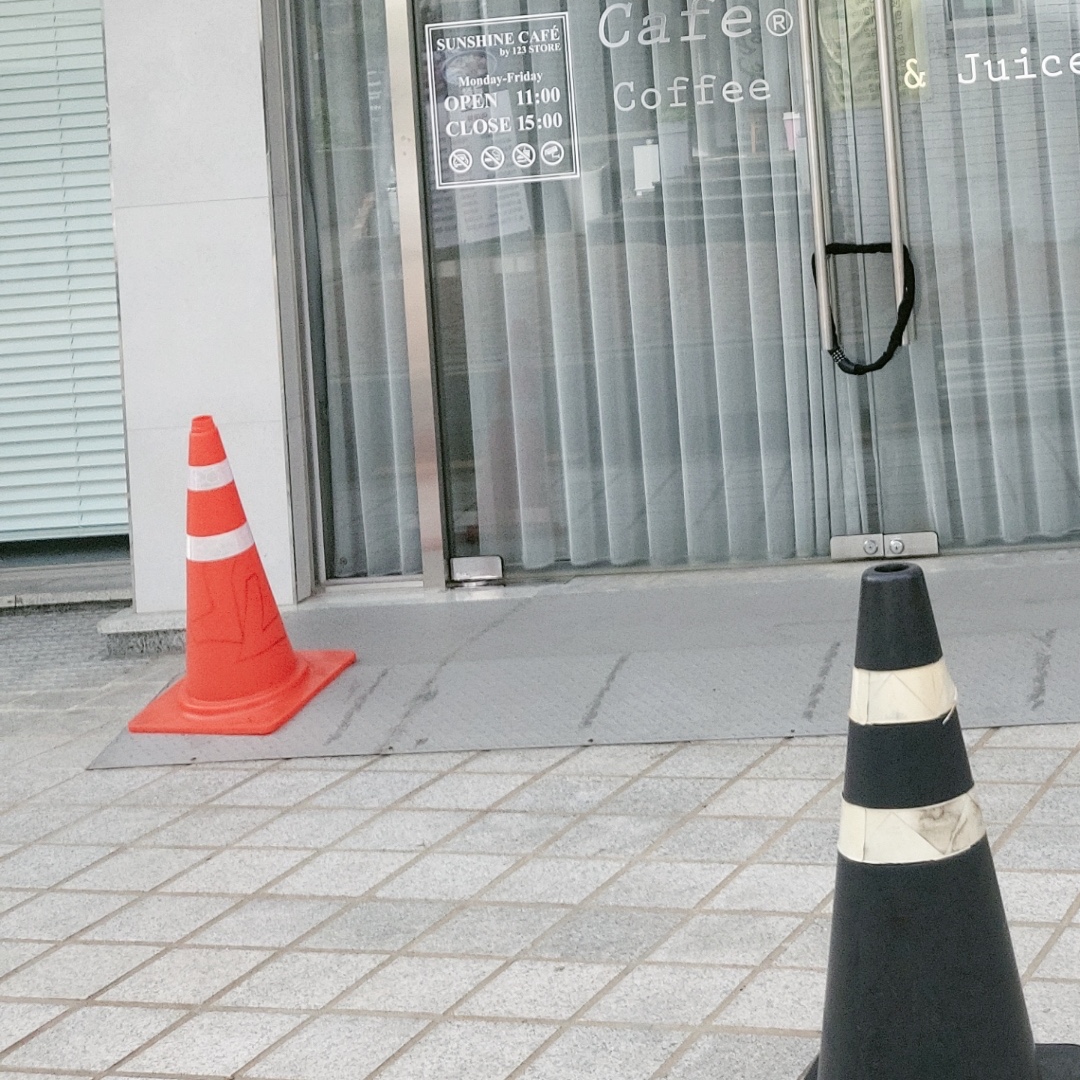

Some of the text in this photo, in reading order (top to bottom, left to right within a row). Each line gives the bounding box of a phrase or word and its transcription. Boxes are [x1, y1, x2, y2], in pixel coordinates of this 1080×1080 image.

[436, 25, 560, 51] SUNSHINE CAFÉ
[499, 43, 562, 58] by 123 STORE
[459, 71, 544, 88] Monday-Friday
[613, 75, 772, 112] Coffee
[904, 58, 927, 89] &
[443, 86, 561, 112] OPEN 11:00
[445, 111, 563, 138] CLOSE 15:00
